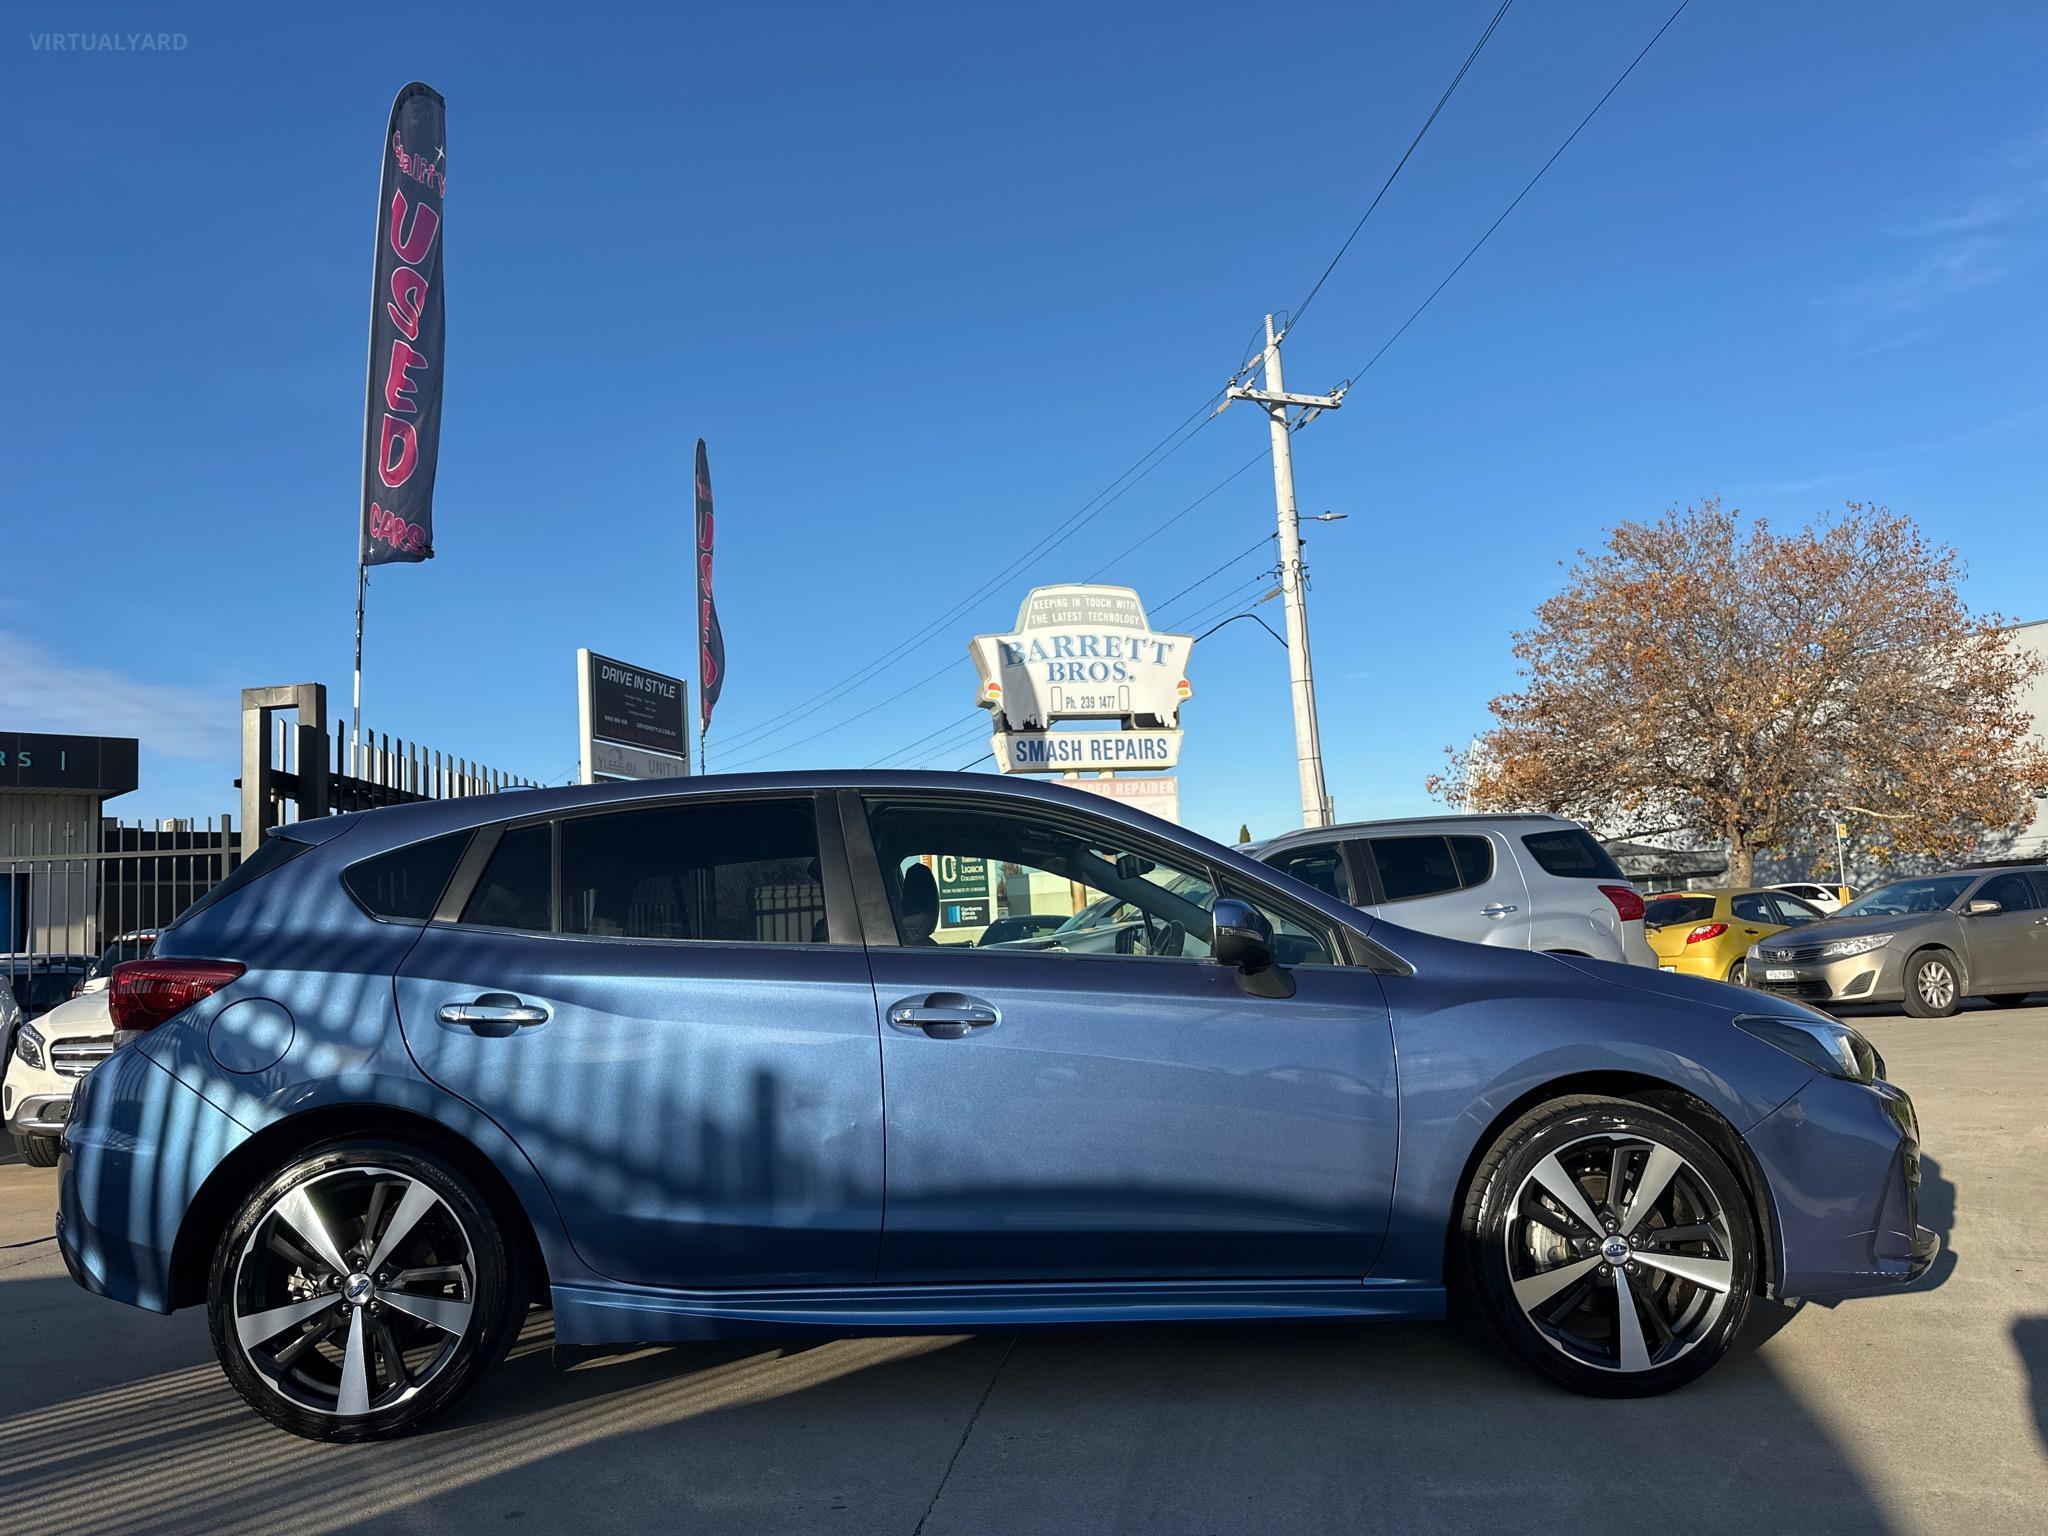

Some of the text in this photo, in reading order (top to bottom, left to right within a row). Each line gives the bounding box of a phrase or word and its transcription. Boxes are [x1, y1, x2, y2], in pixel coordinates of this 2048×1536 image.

[378, 188, 439, 488] USED
[1033, 597, 1136, 610] KEEPING IN TOUCH WITH
[1031, 611, 1140, 625] THE LATEST TECHNOLOGY
[1000, 633, 1175, 668] BARRETT
[601, 665, 633, 687] DRIVE
[633, 675, 643, 690] IN
[645, 678, 676, 699] STYLE
[1046, 660, 1136, 684] BROS.
[1081, 696, 1095, 709] 239
[1099, 696, 1115, 709] 1477
[1016, 737, 1168, 762] SMASH REPAIRS
[1116, 782, 1175, 795] REPAIRER
